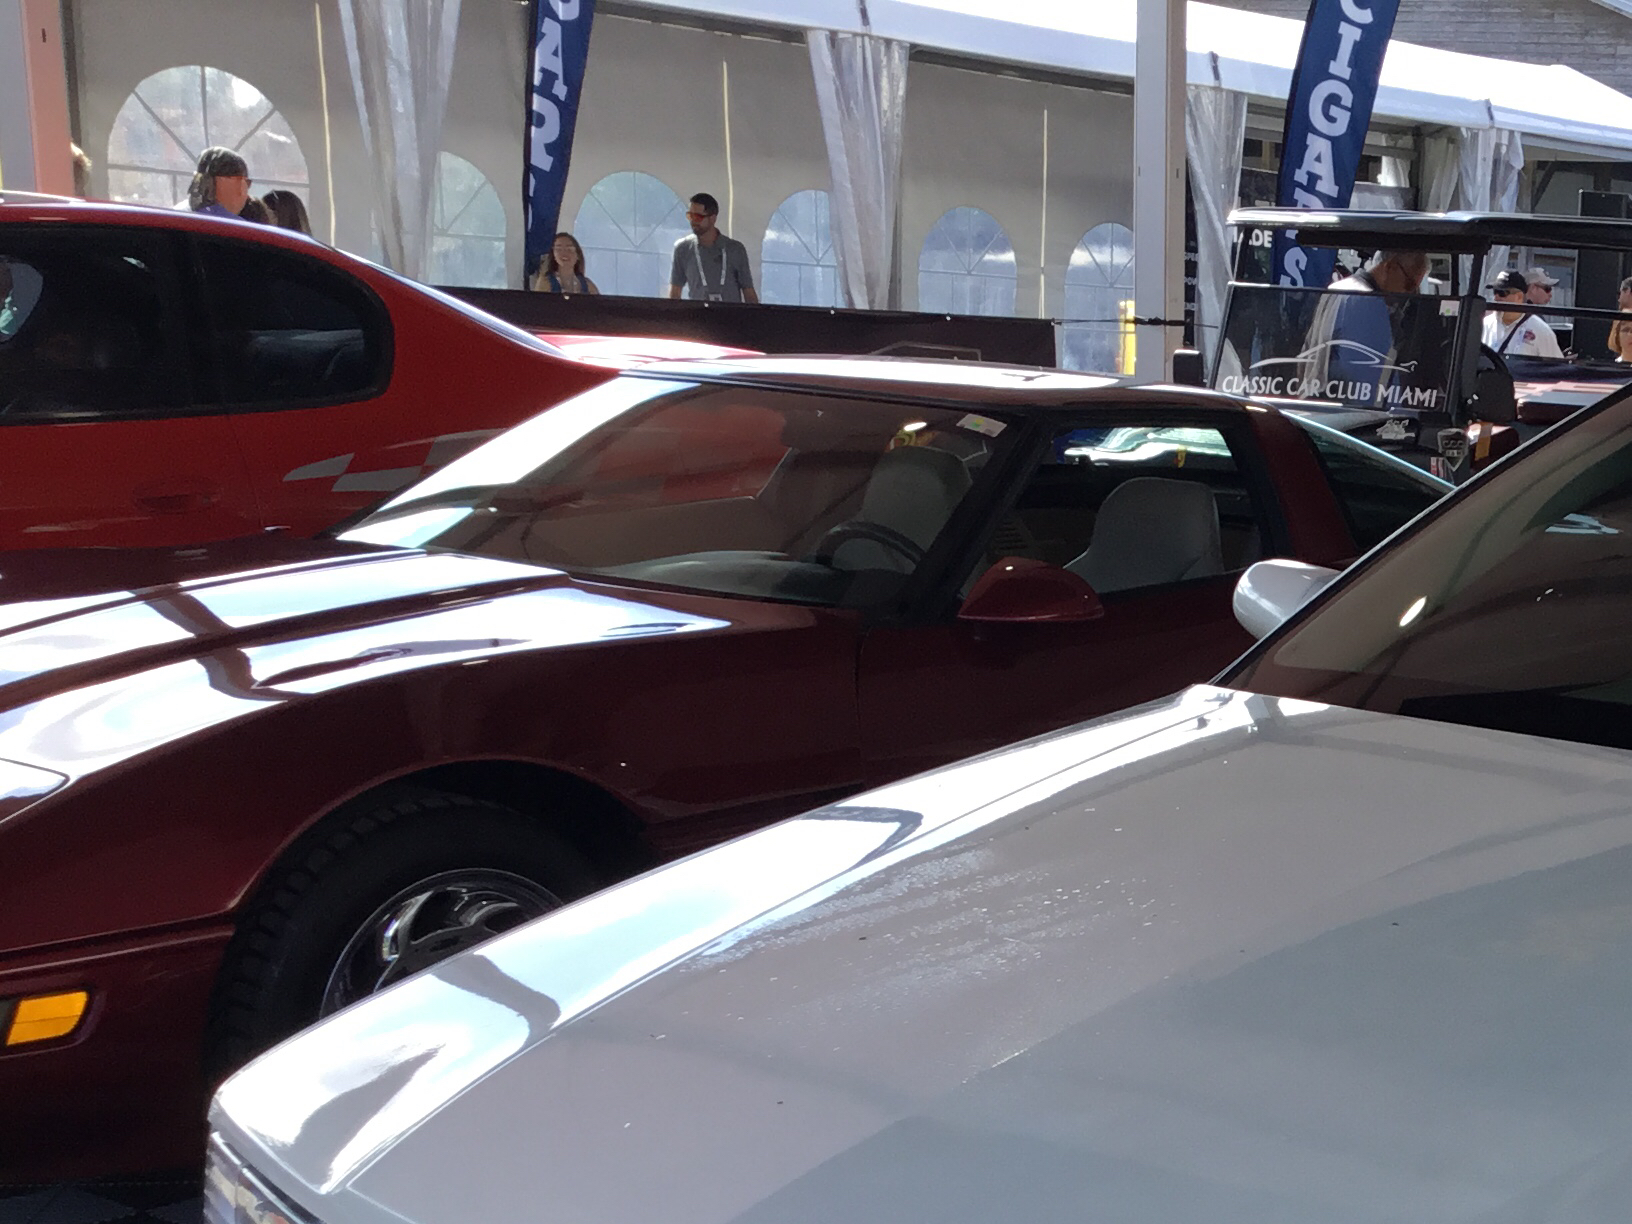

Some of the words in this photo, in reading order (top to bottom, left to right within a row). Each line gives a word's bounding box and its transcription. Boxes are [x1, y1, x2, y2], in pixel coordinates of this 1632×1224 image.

[1222, 375, 1284, 395] CLASSIC
[1286, 378, 1321, 397] CAR
[1325, 380, 1371, 400] CLUB
[1377, 383, 1437, 408] MIAMI
